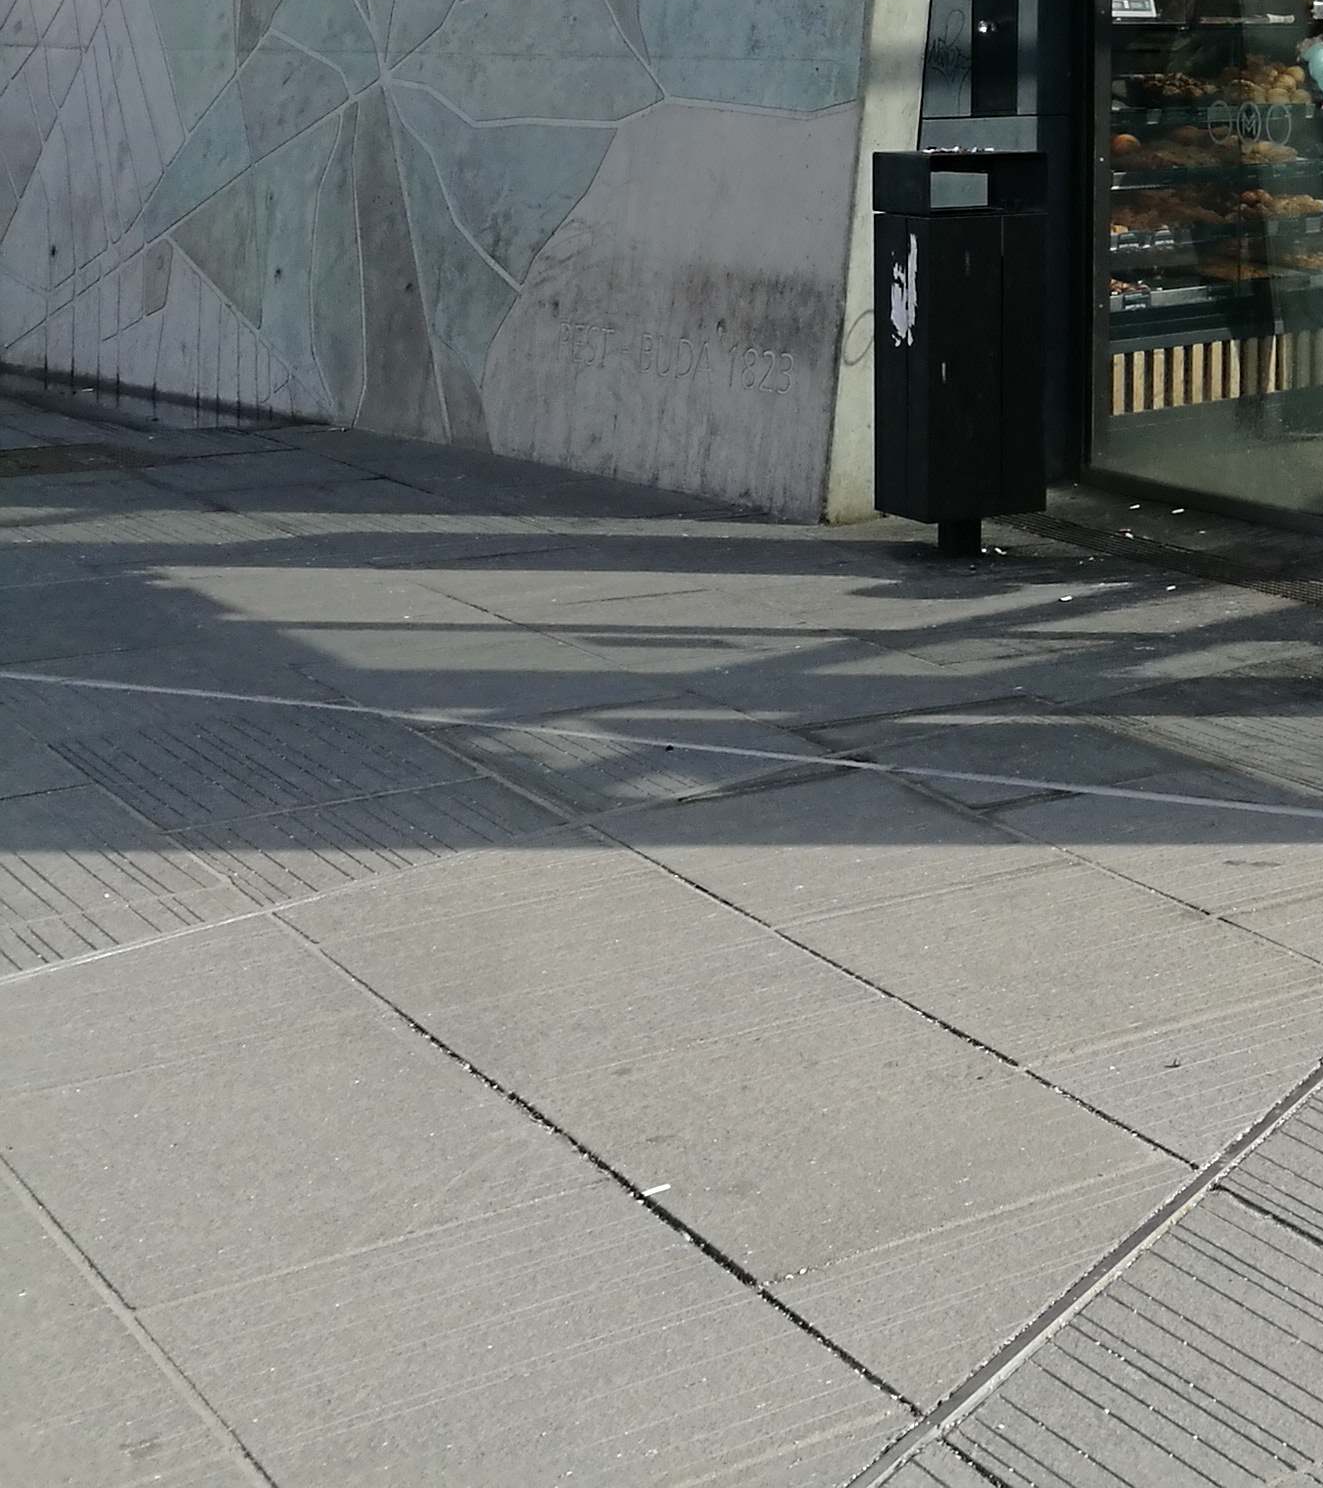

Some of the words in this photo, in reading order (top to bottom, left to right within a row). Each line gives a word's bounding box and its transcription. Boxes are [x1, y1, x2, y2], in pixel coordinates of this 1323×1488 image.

[557, 321, 615, 368] PEST
[639, 332, 713, 381] BUDA
[727, 344, 794, 395] 1823
